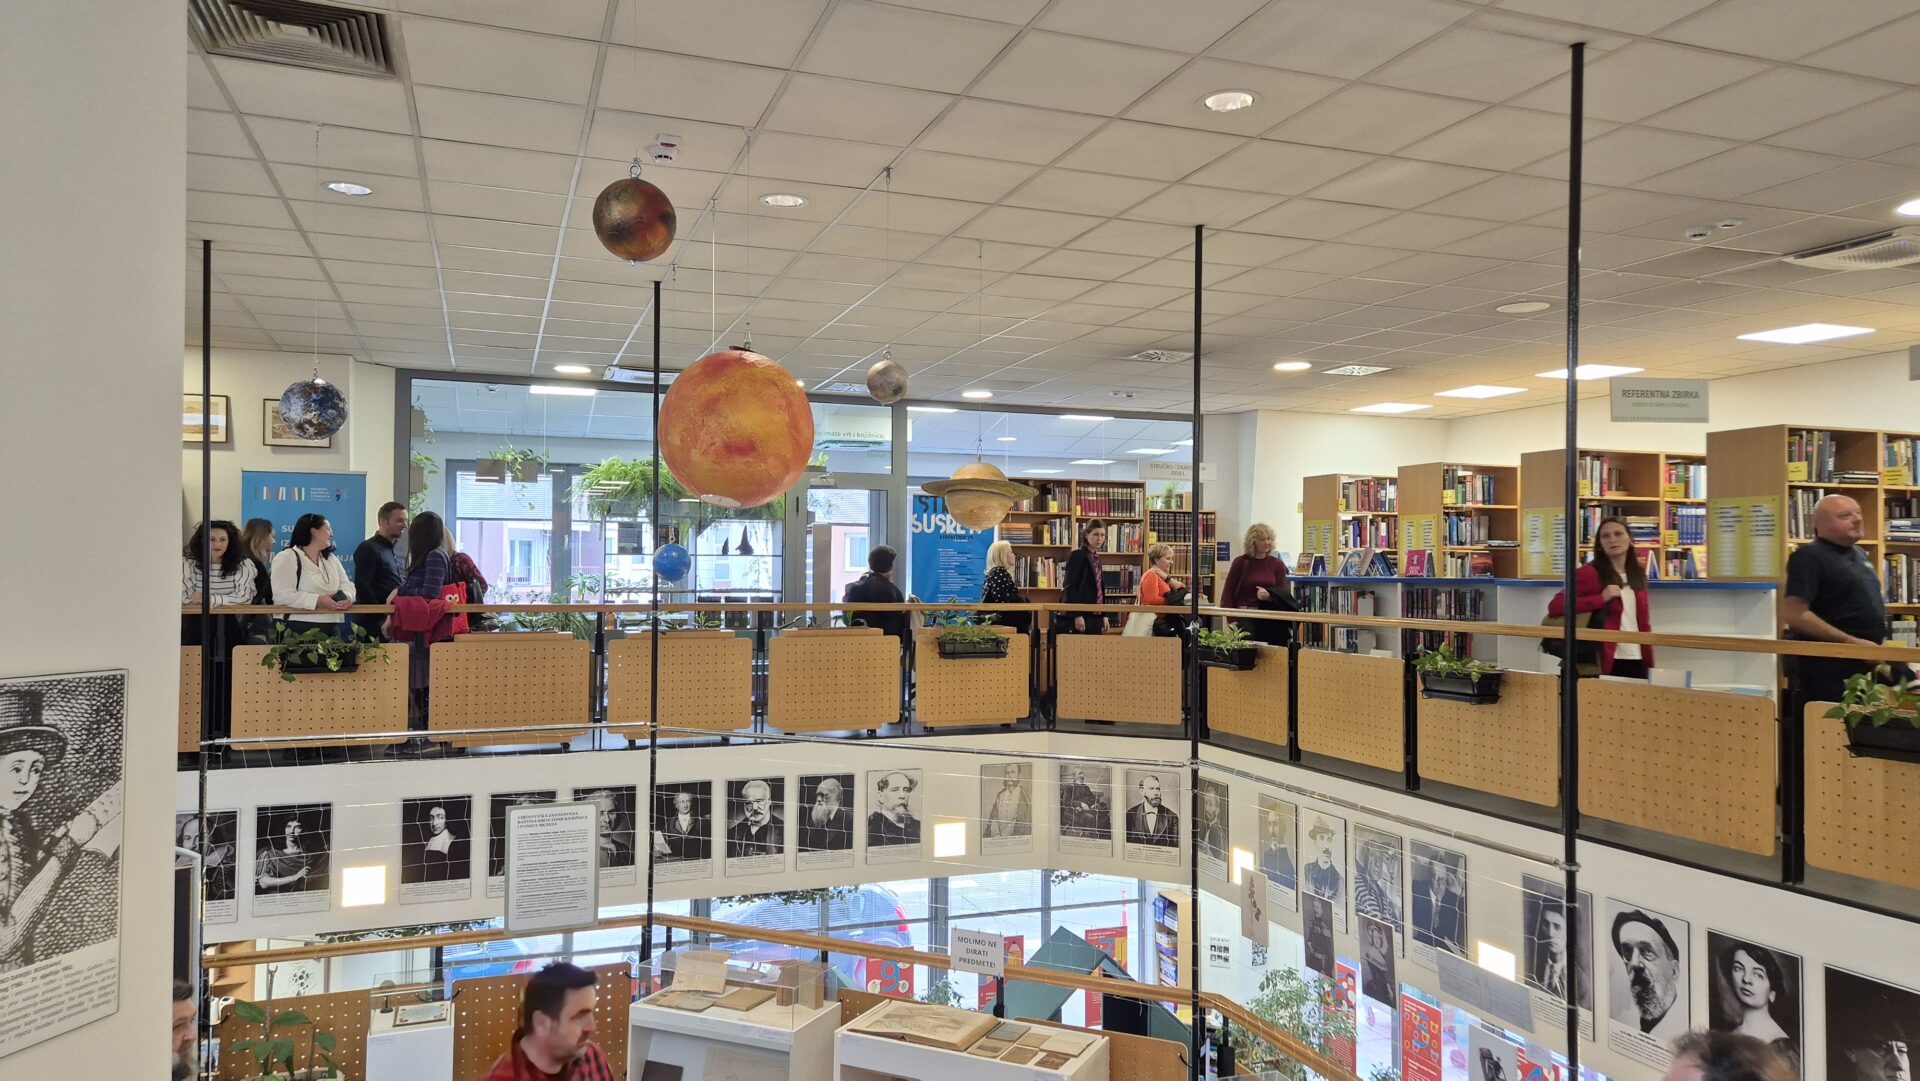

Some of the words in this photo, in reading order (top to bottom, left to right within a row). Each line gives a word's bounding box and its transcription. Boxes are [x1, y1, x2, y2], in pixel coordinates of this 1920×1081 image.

[1621, 389, 1670, 398] REFERENTNA
[1672, 390, 1700, 399] ZBIRKA
[957, 936, 986, 946] MOLIMO
[966, 948, 988, 957] DIRATI
[959, 957, 996, 968] PREDMETE!
[881, 959, 900, 992] 9
